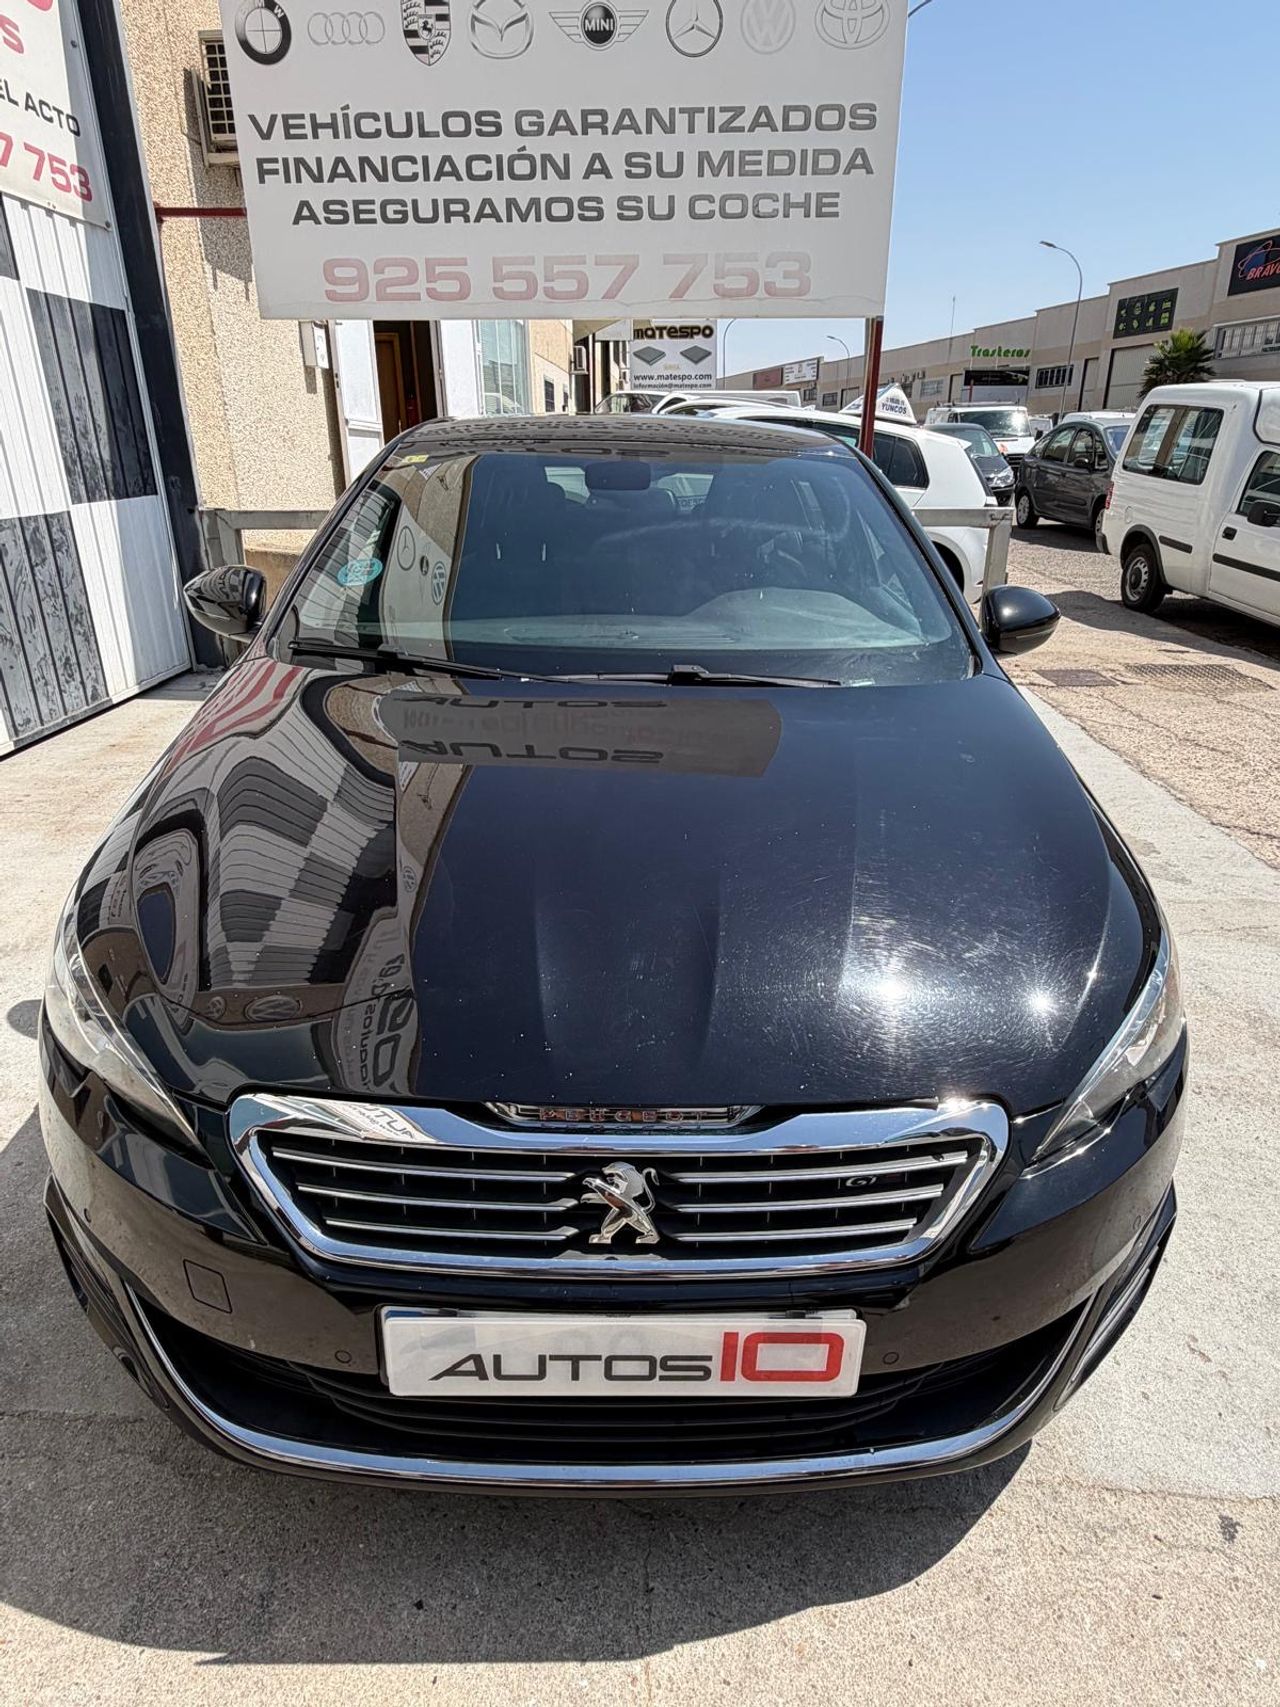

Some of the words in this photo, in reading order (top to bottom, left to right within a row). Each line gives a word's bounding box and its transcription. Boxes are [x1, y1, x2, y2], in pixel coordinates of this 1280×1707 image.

[584, 18, 614, 31] MINI
[25, 92, 81, 137] ACTO
[248, 103, 503, 141] VEHÍCULOS
[513, 102, 878, 137] GARANTIZADOS
[23, 142, 93, 202] 753
[255, 145, 571, 185] FINANCIACIÓN
[582, 152, 613, 180] A
[624, 151, 684, 180] SU
[697, 147, 875, 178] MEDIDA
[292, 196, 605, 225] ASEGURAMOS
[616, 195, 676, 221] SU
[687, 192, 841, 220] COCHE
[322, 256, 472, 304] 925
[491, 253, 640, 302] 557
[662, 251, 812, 300] 753
[970, 345, 1031, 358] Trasteros
[633, 373, 712, 382] www.matespo.com
[881, 402, 907, 415] YUNCOS
